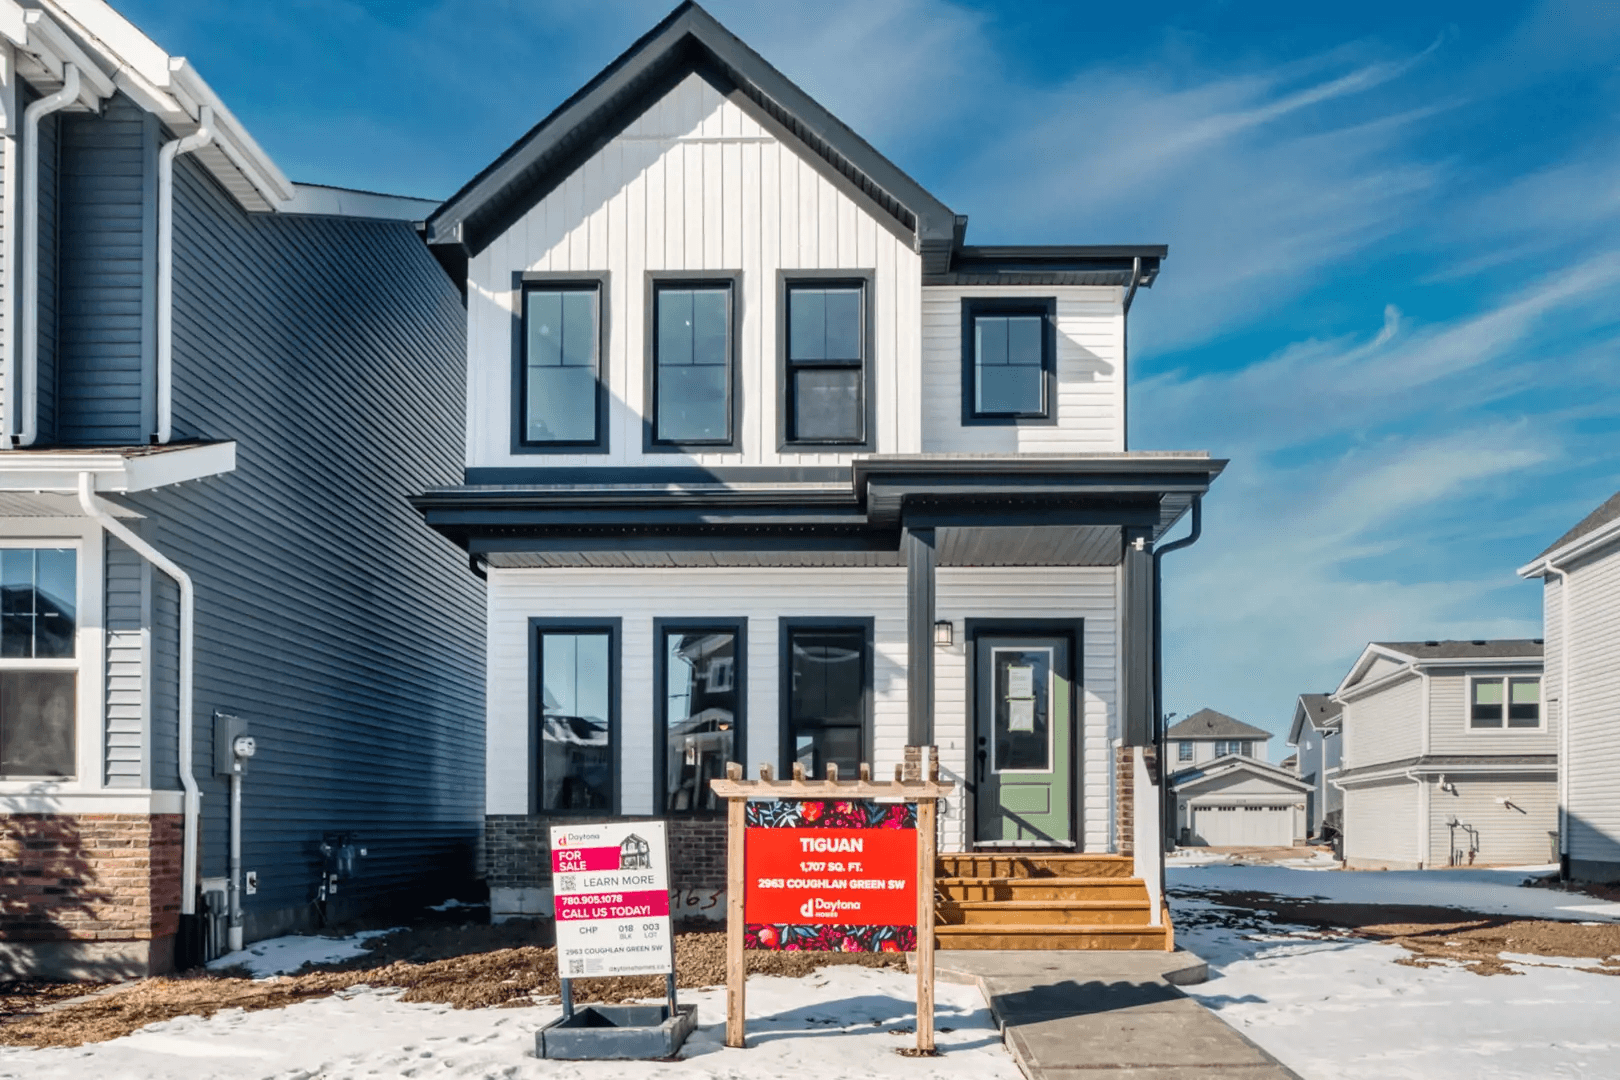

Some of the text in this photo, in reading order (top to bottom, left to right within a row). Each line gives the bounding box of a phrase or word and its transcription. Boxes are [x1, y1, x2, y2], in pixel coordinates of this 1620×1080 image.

[568, 833, 600, 841] Daytona
[799, 838, 863, 852] TIGUAN
[558, 851, 582, 861] FOR
[559, 861, 587, 871] SALE
[799, 862, 863, 872] 1,707 SQ. FT.
[583, 875, 655, 888] LEARN MORE
[757, 879, 906, 889] 2963 COUGHLAN GREEN SW
[561, 894, 623, 906] 780.905.1078
[815, 898, 861, 911] Daytona
[562, 905, 651, 919] CALL US TODAY!
[579, 923, 660, 934] CHP 018 003
[565, 947, 583, 956] 2963
[584, 946, 625, 955] COUGHLAN
[626, 945, 650, 953] GREEN
